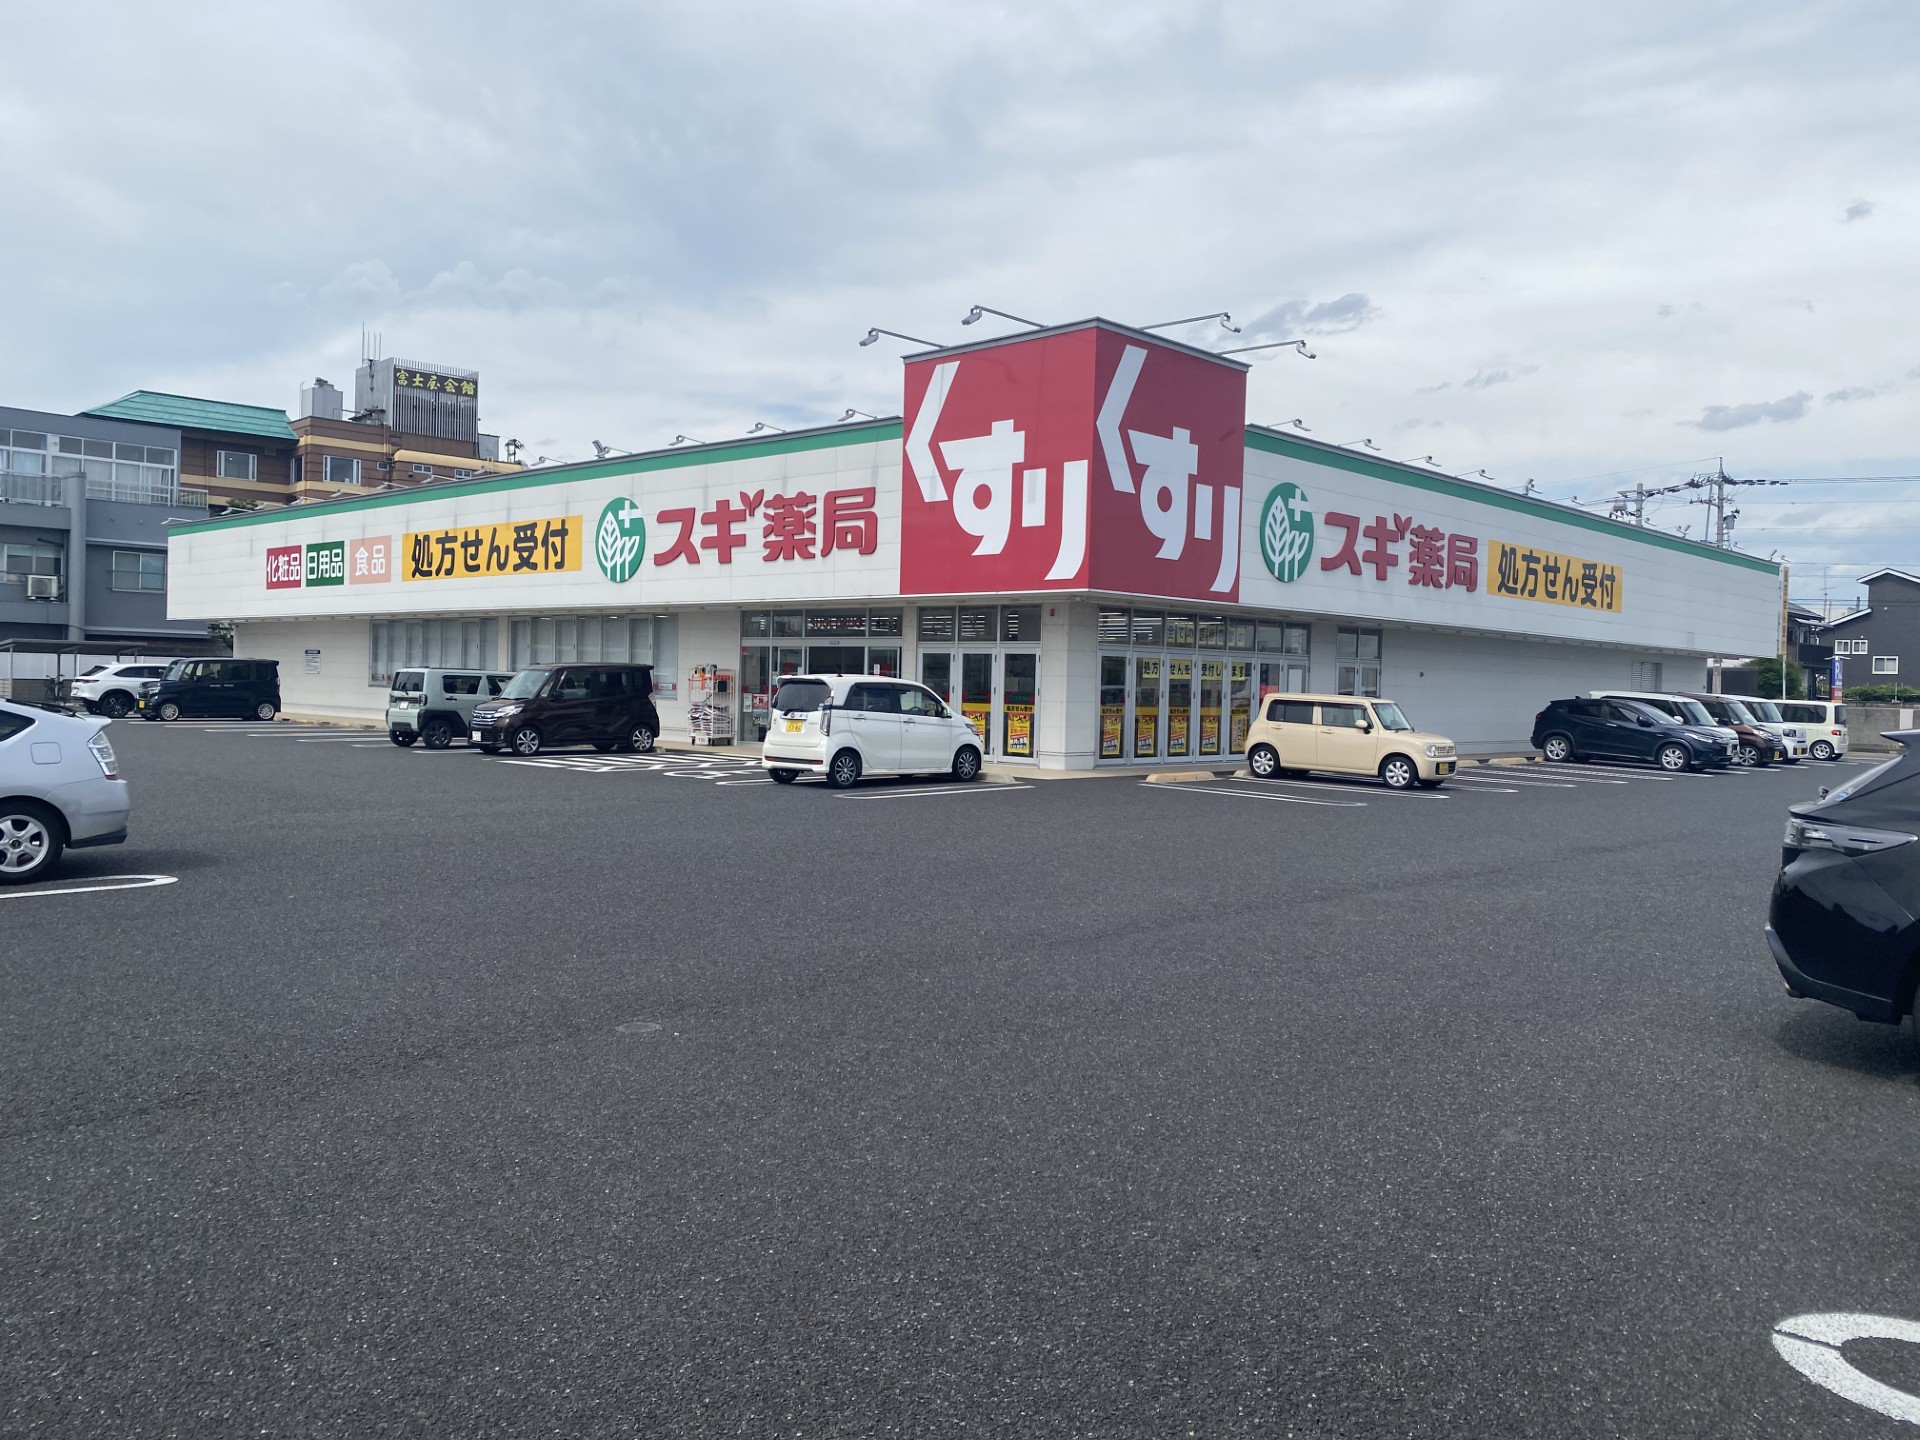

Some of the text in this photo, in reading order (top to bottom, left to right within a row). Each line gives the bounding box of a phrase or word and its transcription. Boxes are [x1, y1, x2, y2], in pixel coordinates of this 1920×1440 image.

[396, 370, 475, 395] 富士屋会館
[905, 361, 1088, 580] くすり
[1096, 344, 1241, 591] くすり
[411, 519, 569, 579] 処方せん受付
[654, 486, 878, 567] スギ薬局
[1320, 512, 1479, 592] スギ薬局
[266, 552, 300, 583] 化粧品
[306, 547, 344, 580] 日用品
[354, 544, 386, 576] 食品
[1497, 543, 1616, 610] 処方せん受付
